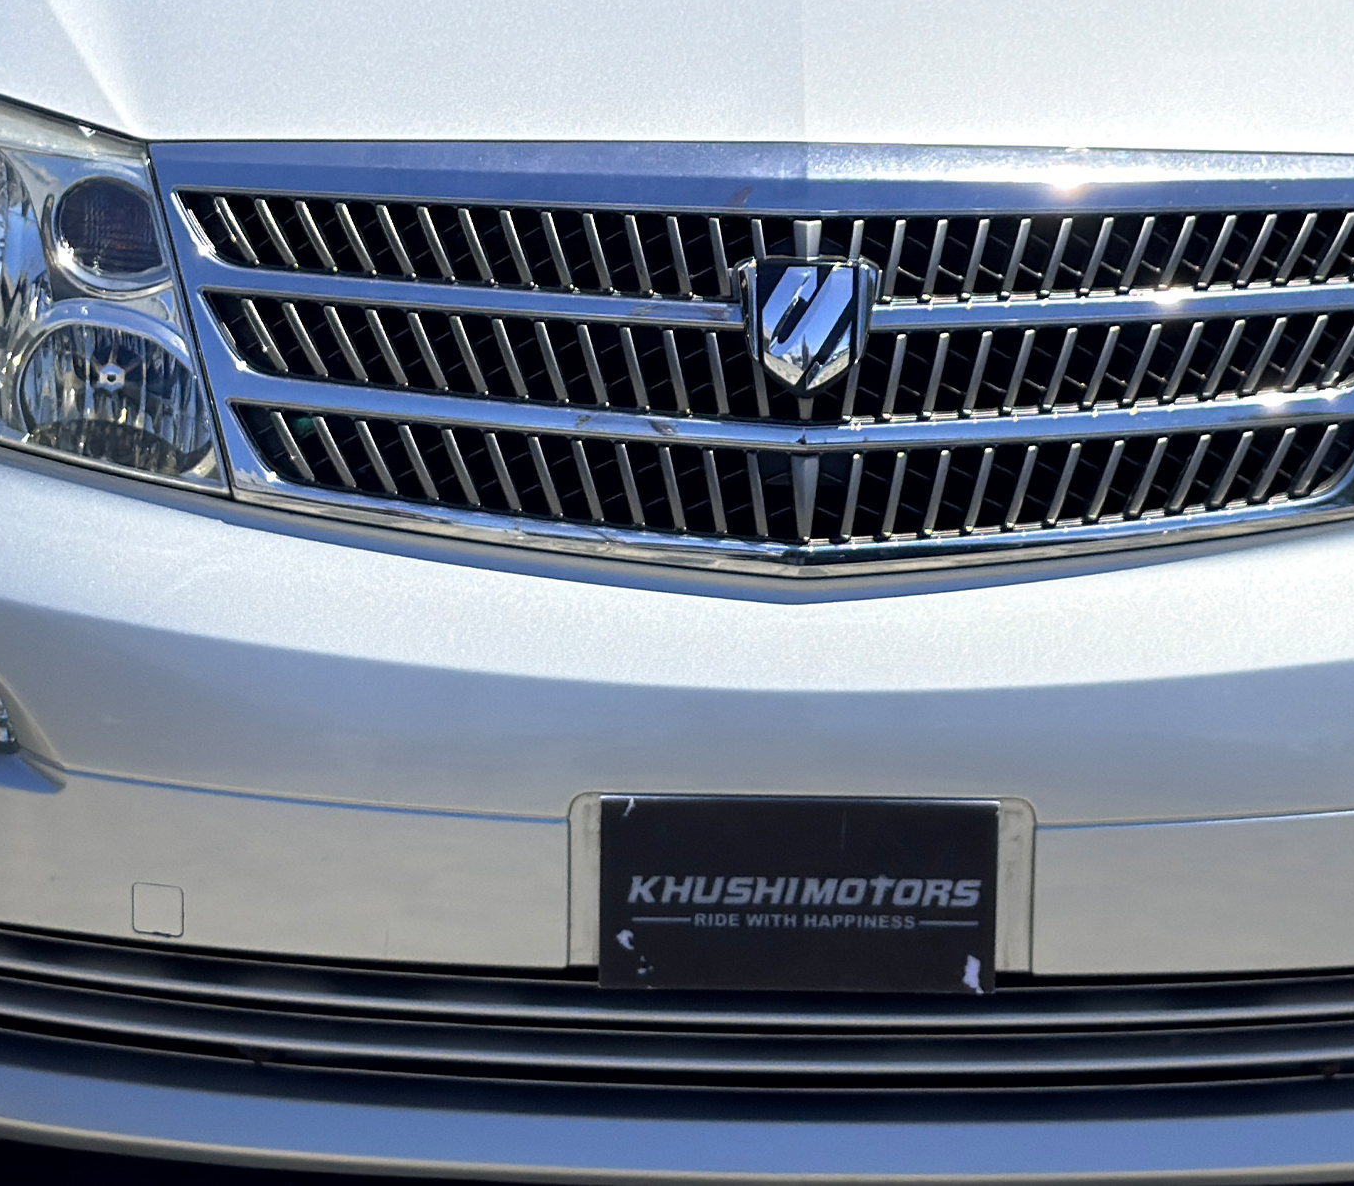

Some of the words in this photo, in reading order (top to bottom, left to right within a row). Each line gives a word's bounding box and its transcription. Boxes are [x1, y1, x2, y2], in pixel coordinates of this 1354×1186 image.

[694, 913, 740, 927] RIDE
[746, 914, 797, 928] WITH
[803, 914, 916, 929] HAPPINESS
